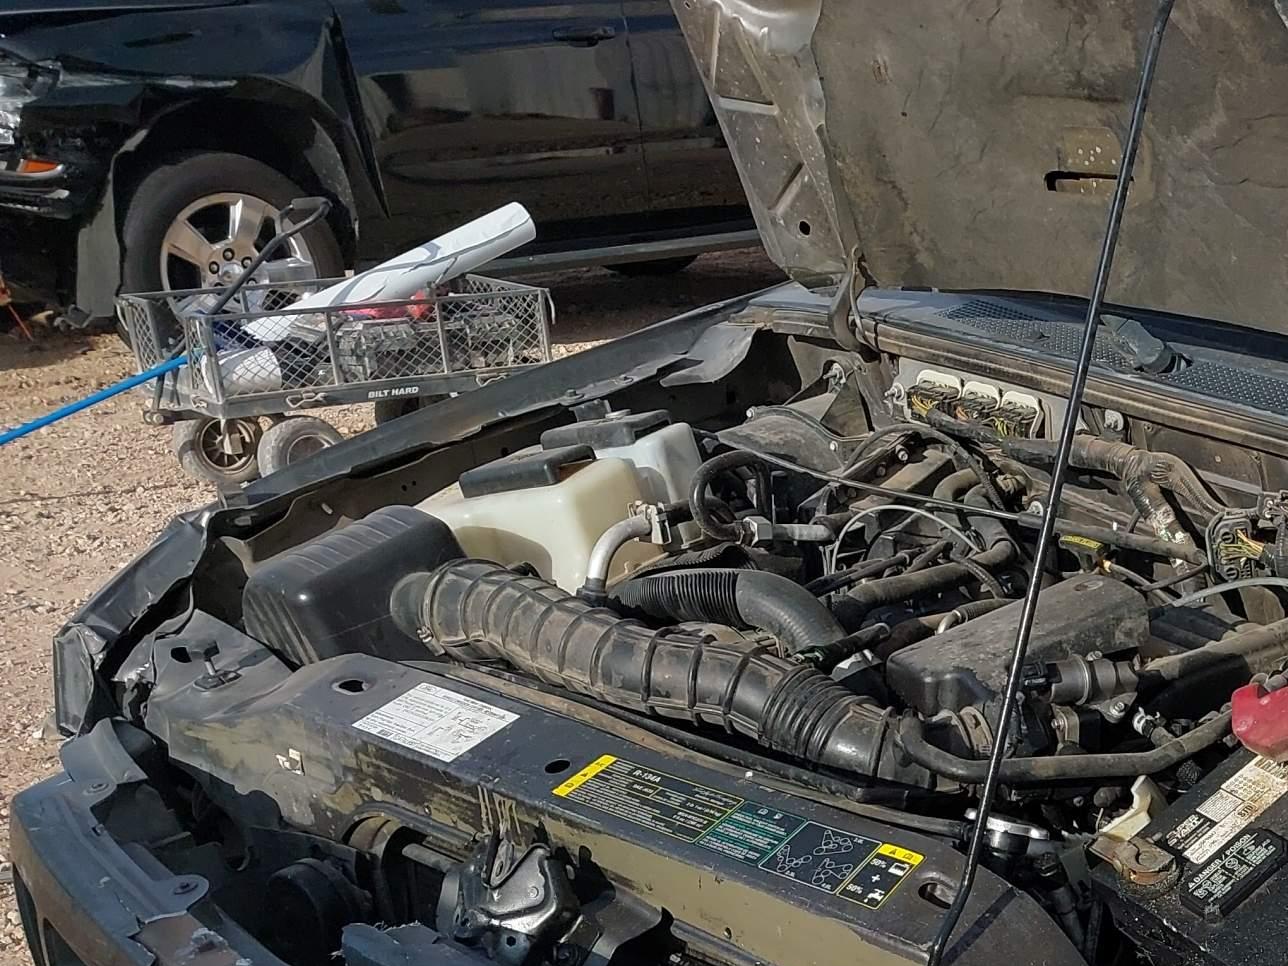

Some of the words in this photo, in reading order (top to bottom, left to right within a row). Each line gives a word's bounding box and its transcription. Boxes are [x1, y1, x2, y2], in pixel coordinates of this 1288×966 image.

[368, 390, 389, 398] BILT
[392, 386, 419, 396] HARD
[632, 769, 662, 783] R-134A
[869, 858, 887, 869] 50%
[1193, 858, 1223, 883] DANGER
[1224, 833, 1252, 856] POISON
[846, 883, 864, 894] 50%
